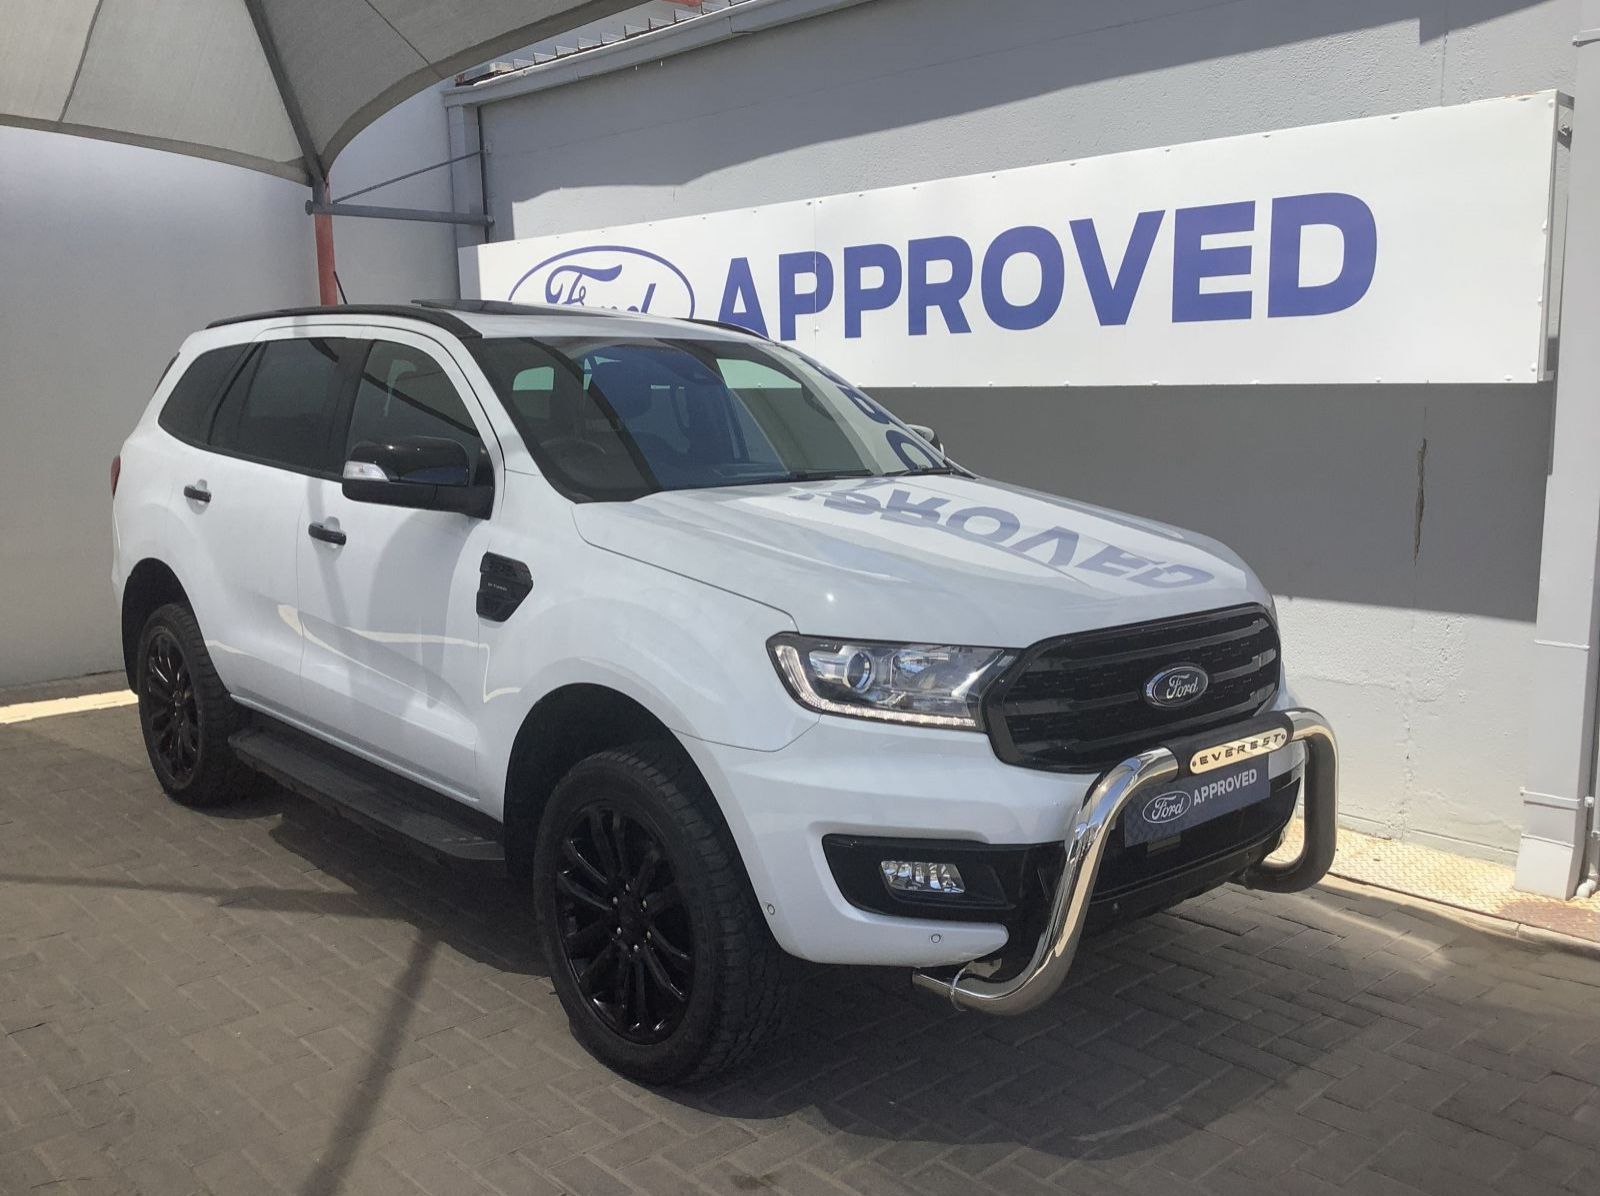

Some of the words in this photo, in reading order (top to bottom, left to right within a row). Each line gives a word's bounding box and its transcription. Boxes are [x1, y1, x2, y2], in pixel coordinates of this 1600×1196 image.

[717, 192, 1378, 342] APPROVED
[1165, 673, 1199, 700] Ford
[1199, 732, 1282, 766] EVEREST
[1151, 794, 1185, 821] Ford
[1193, 768, 1258, 807] APPROVED
